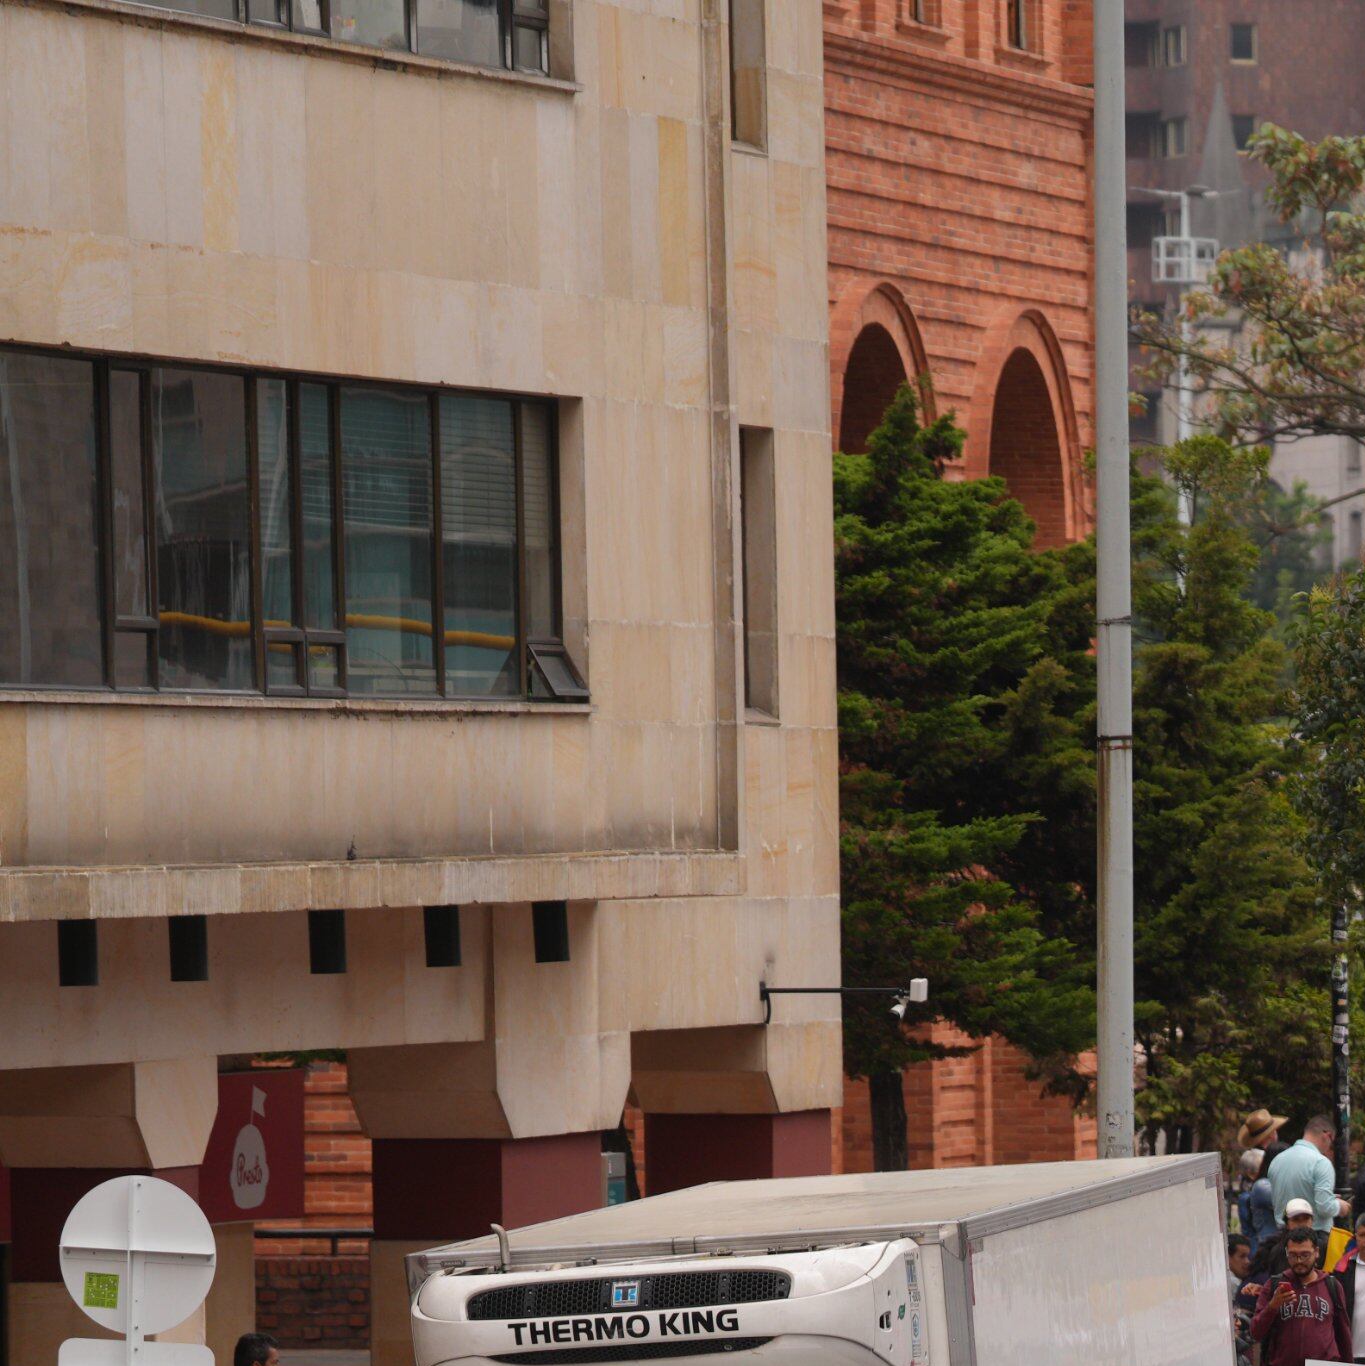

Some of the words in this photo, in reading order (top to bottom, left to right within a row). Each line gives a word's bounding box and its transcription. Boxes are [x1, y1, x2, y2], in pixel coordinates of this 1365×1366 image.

[1281, 1294, 1329, 1320] GAP
[508, 1314, 650, 1346] THERMO
[659, 1309, 739, 1336] KING
